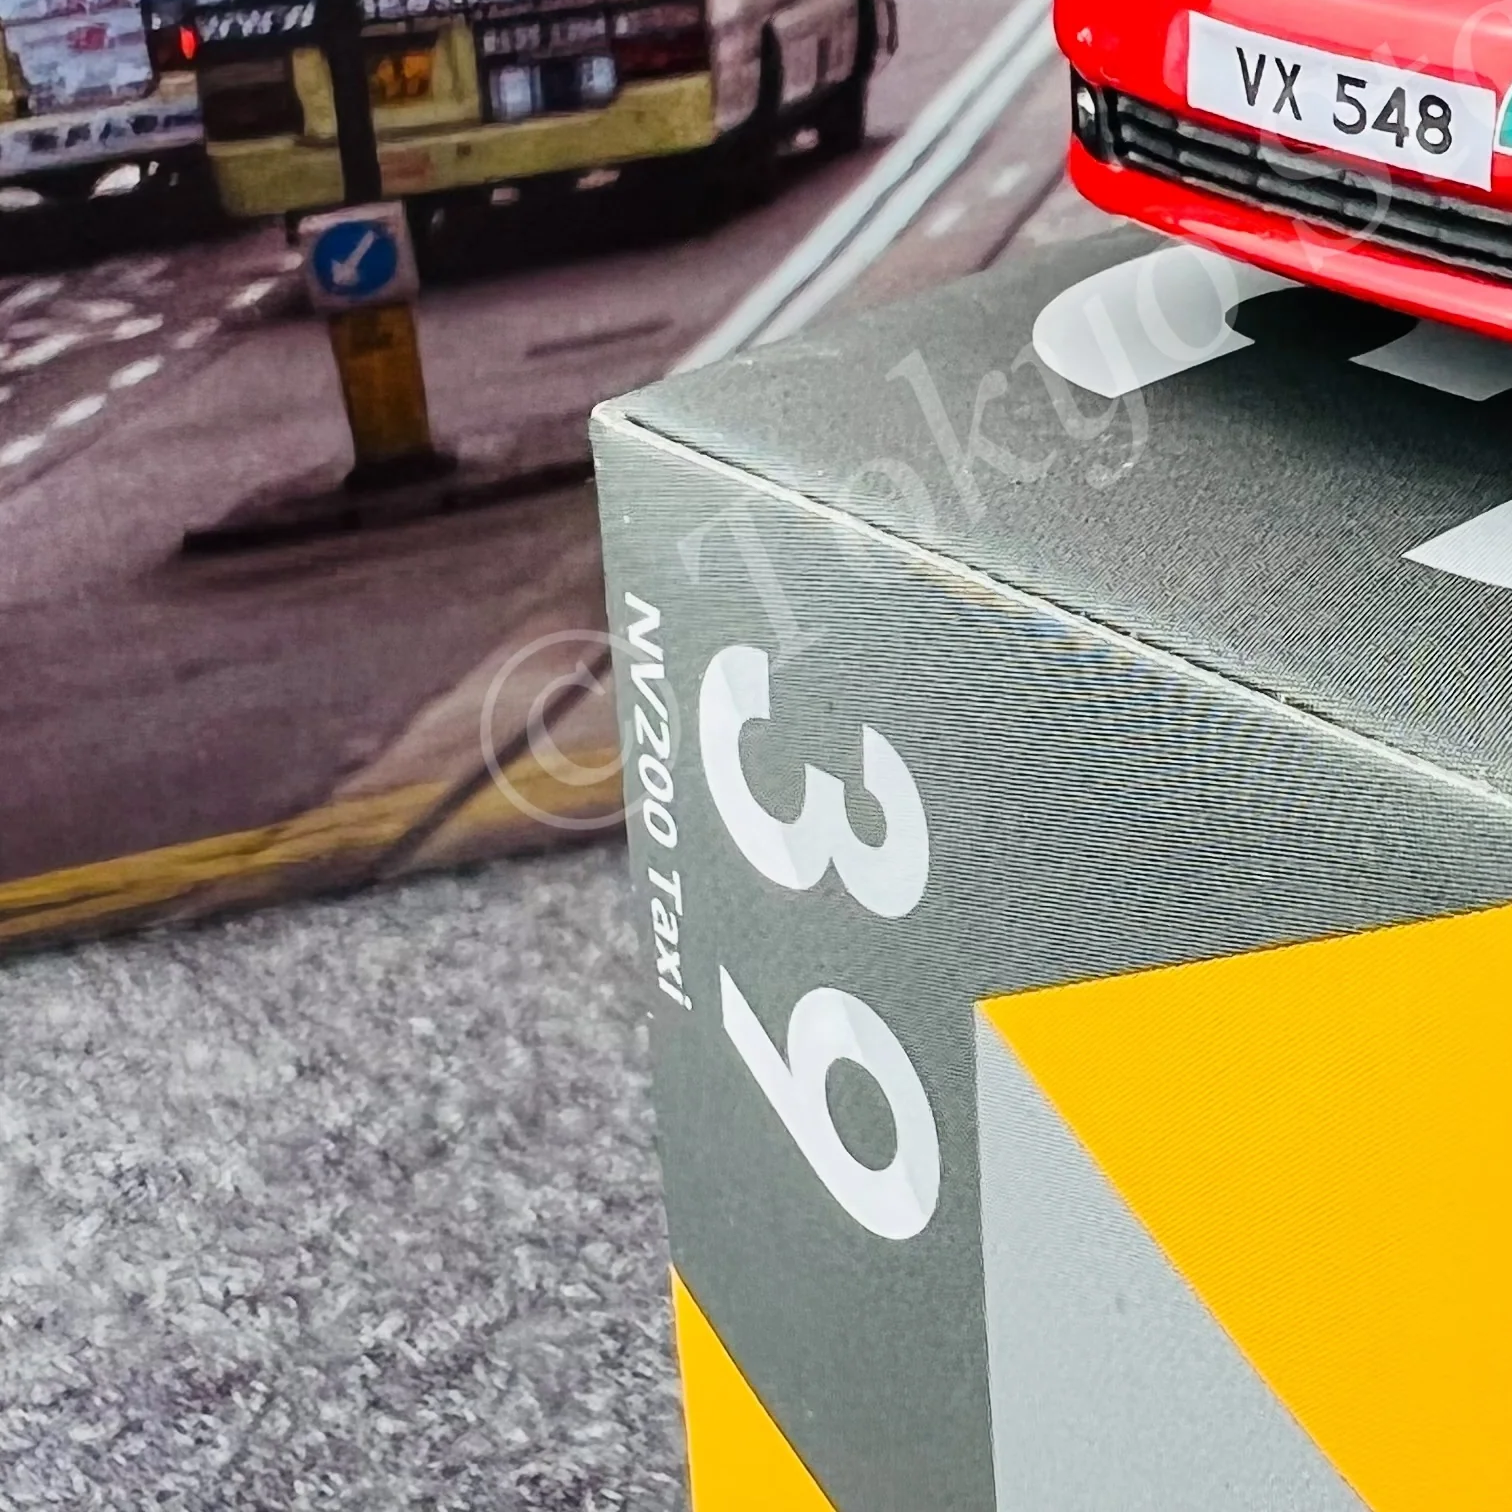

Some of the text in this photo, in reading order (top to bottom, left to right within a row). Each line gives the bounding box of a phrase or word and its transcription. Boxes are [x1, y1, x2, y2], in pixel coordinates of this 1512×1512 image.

[1236, 46, 1453, 155] VX 548
[624, 591, 692, 1011] NV200 Taxi
[699, 644, 941, 1240] 39
